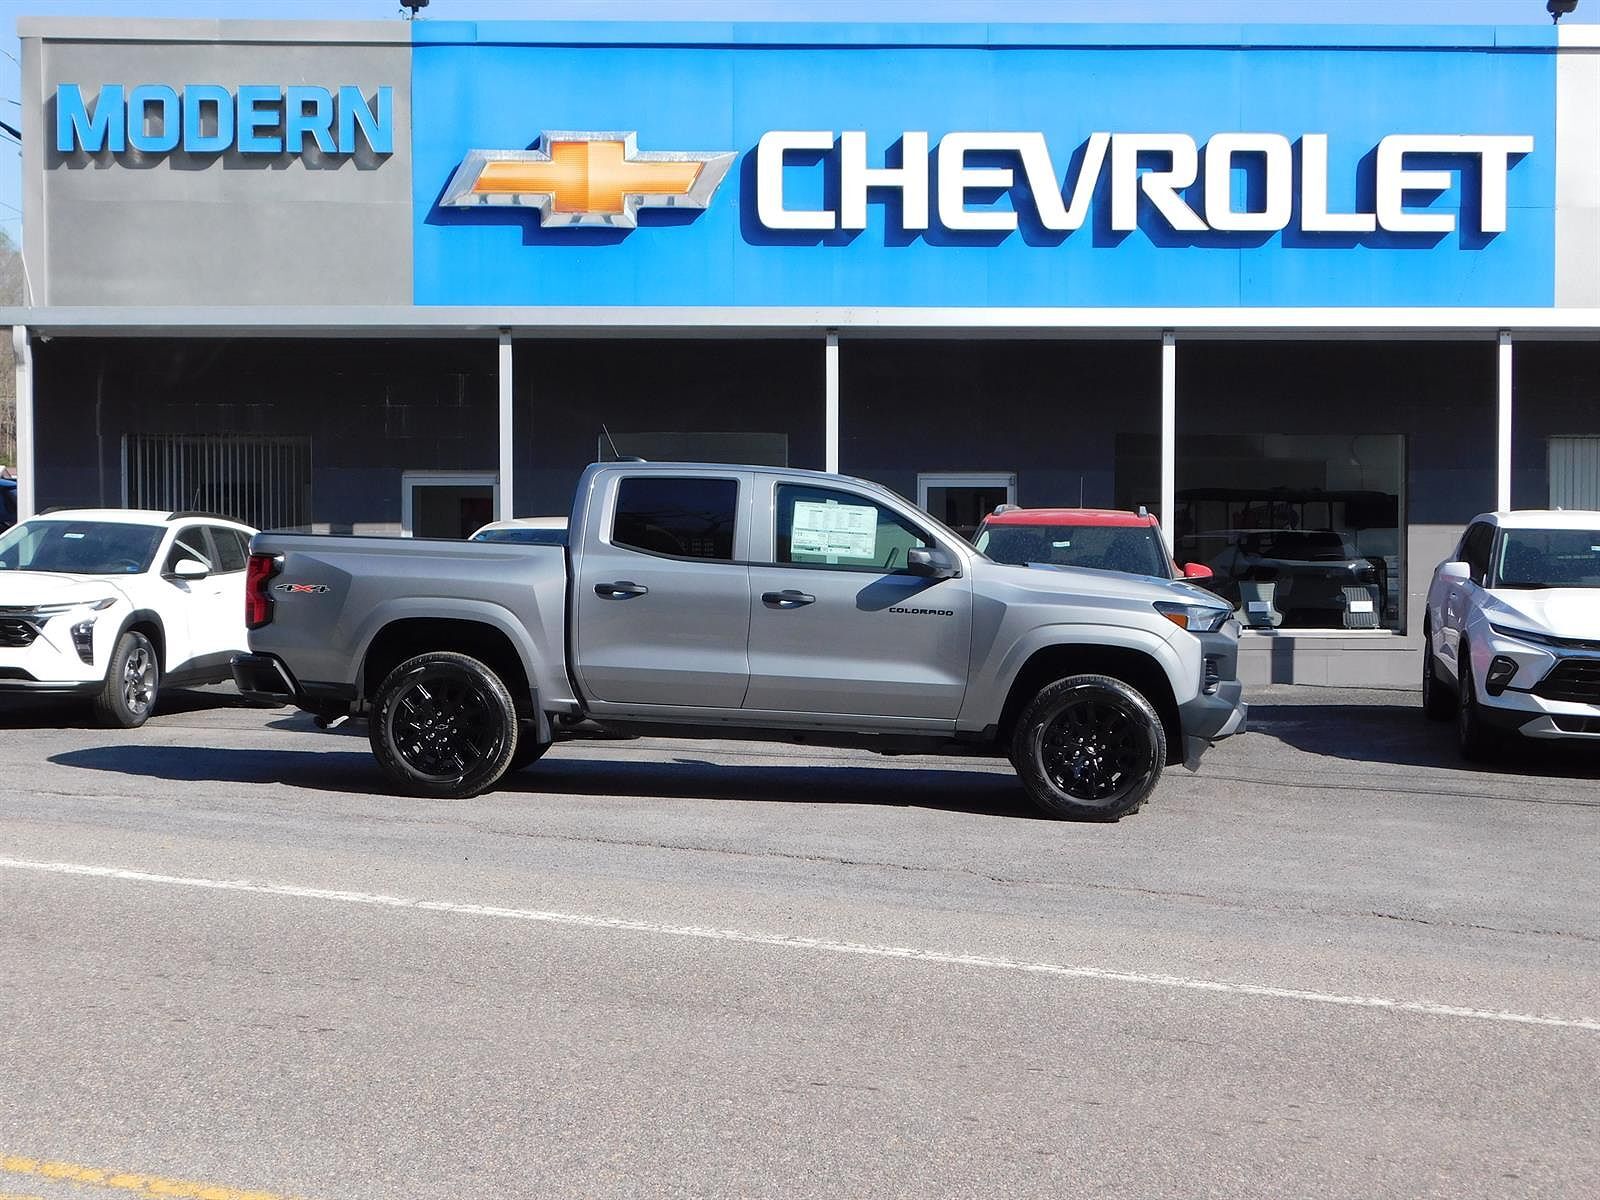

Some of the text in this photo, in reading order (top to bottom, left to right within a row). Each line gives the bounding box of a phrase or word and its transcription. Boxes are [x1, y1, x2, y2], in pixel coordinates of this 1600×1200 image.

[56, 83, 394, 155] MODERN
[757, 130, 1535, 234] CHEVROLET
[888, 607, 954, 616] COLORADO
